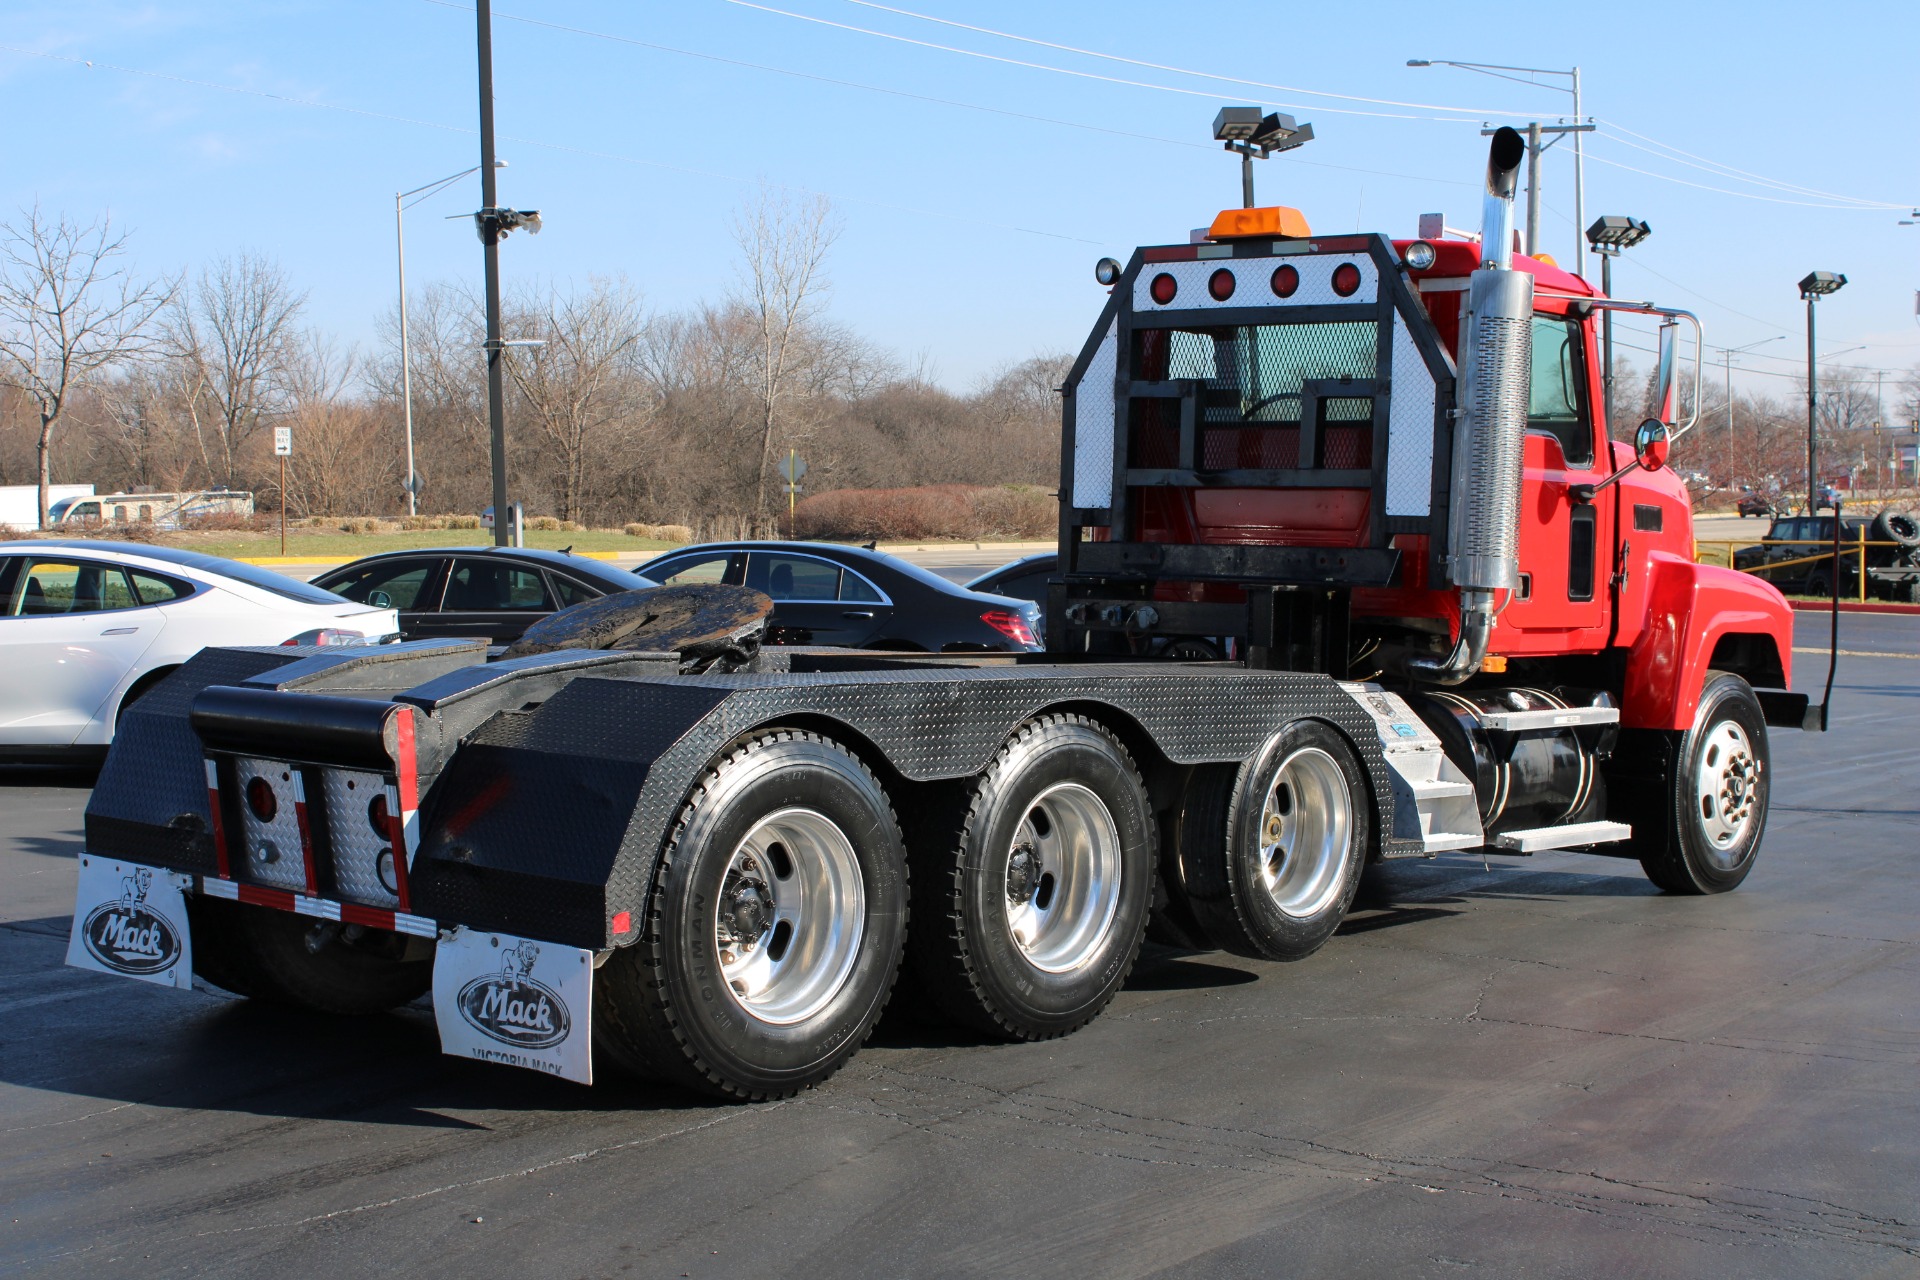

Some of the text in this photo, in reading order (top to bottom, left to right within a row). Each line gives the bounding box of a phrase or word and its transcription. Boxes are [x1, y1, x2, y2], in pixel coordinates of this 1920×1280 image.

[276, 429, 289, 437] ONE
[98, 913, 164, 961] Mack
[478, 985, 555, 1035] Mack
[472, 1047, 563, 1075] VICTORIA MACK
